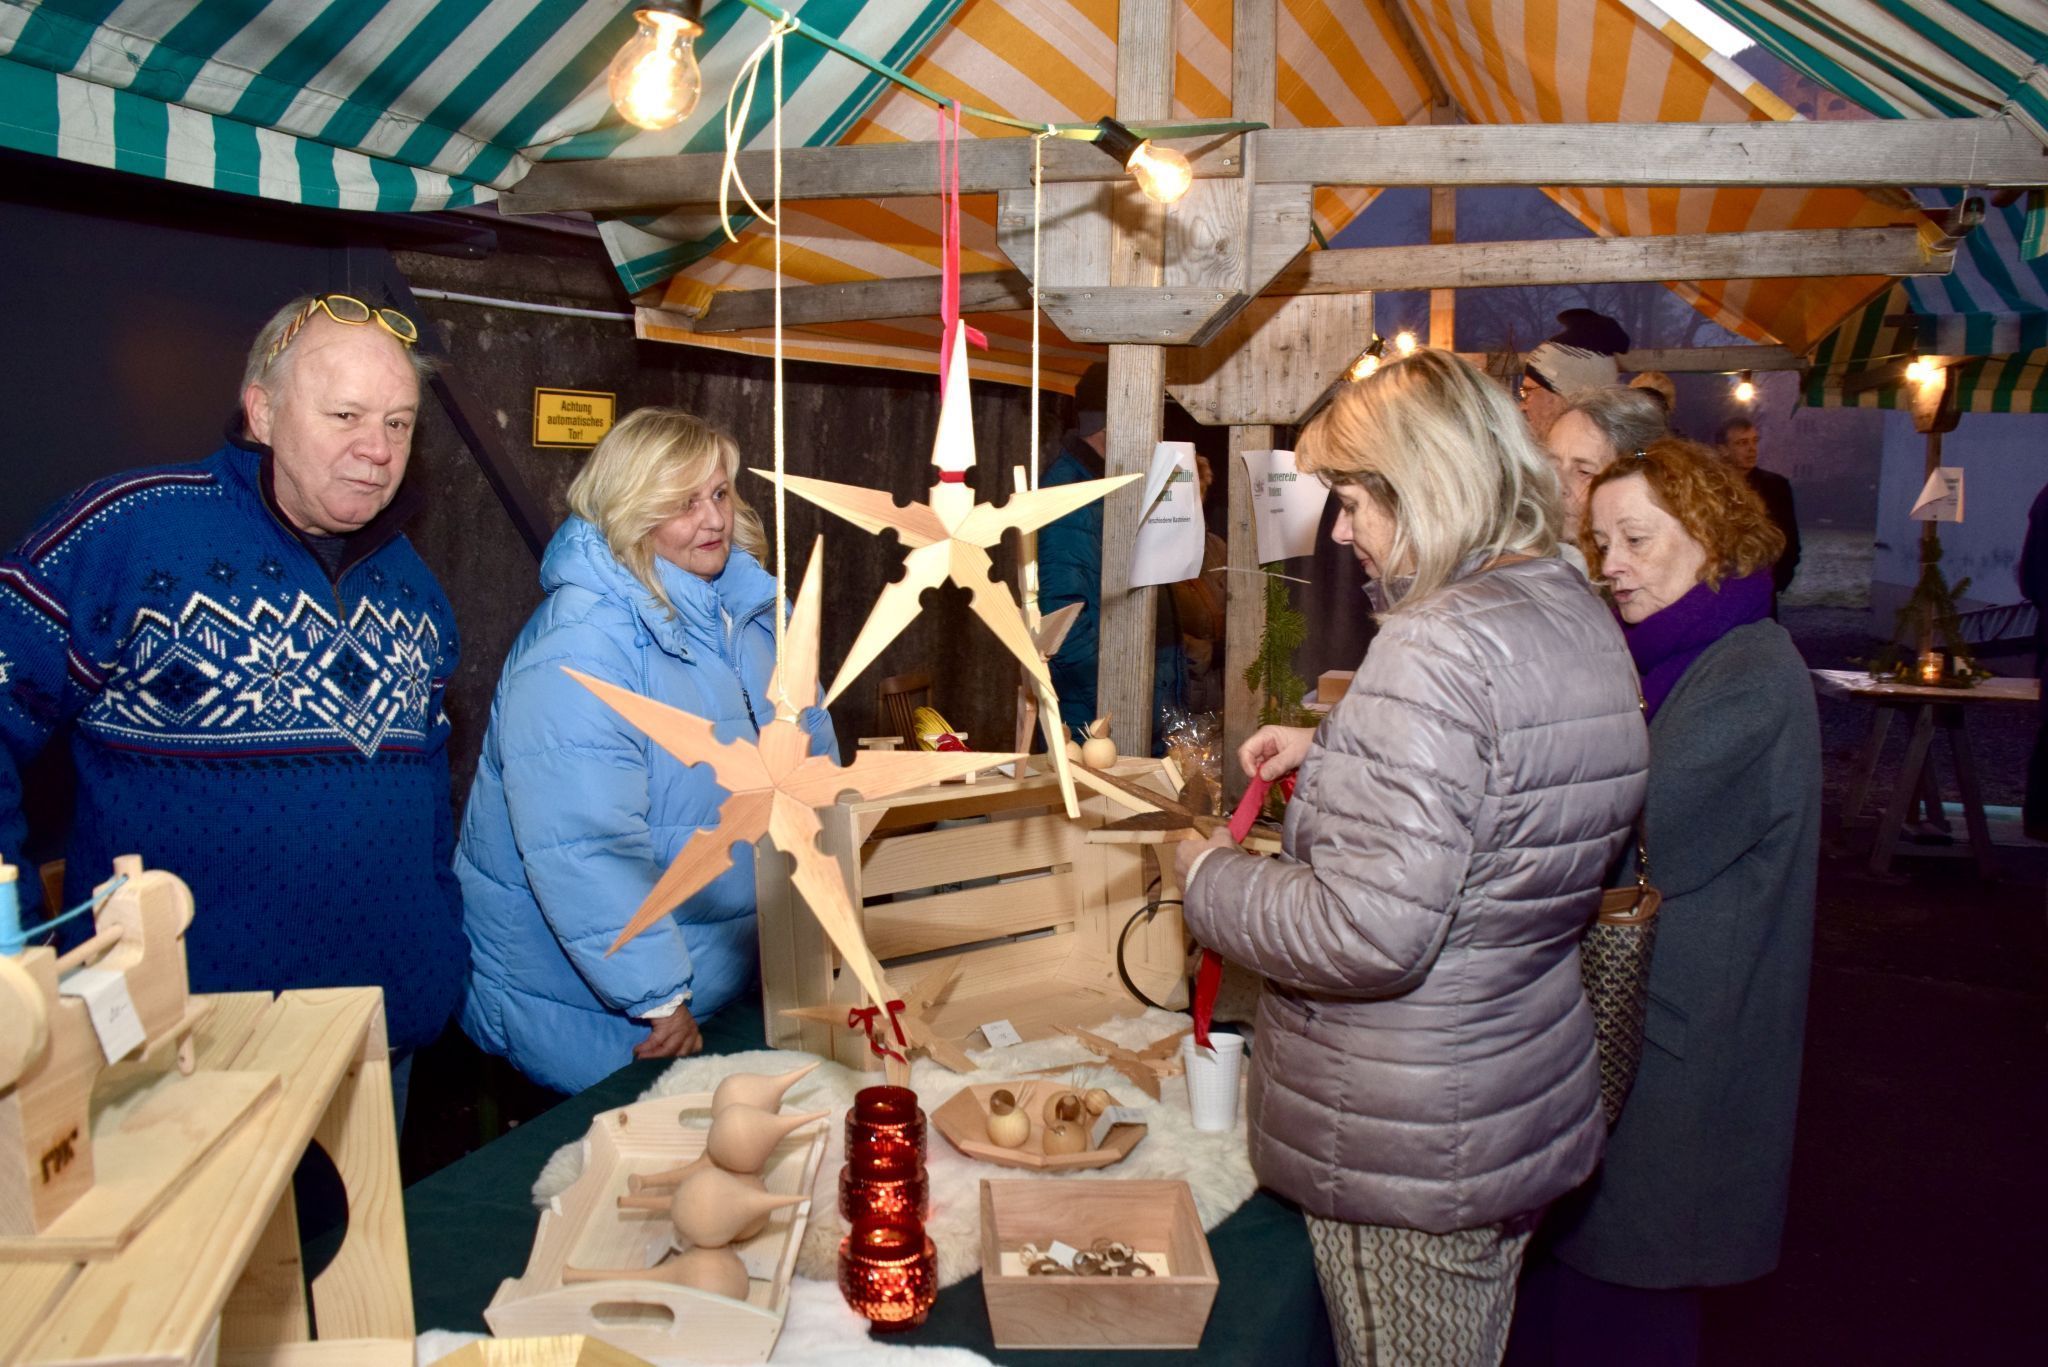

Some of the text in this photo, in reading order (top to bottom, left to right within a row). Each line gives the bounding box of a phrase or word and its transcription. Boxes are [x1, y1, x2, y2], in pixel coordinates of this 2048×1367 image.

[561, 400, 592, 415] Achtung
[547, 415, 604, 427] automatisches
[568, 428, 583, 440] Tor!
